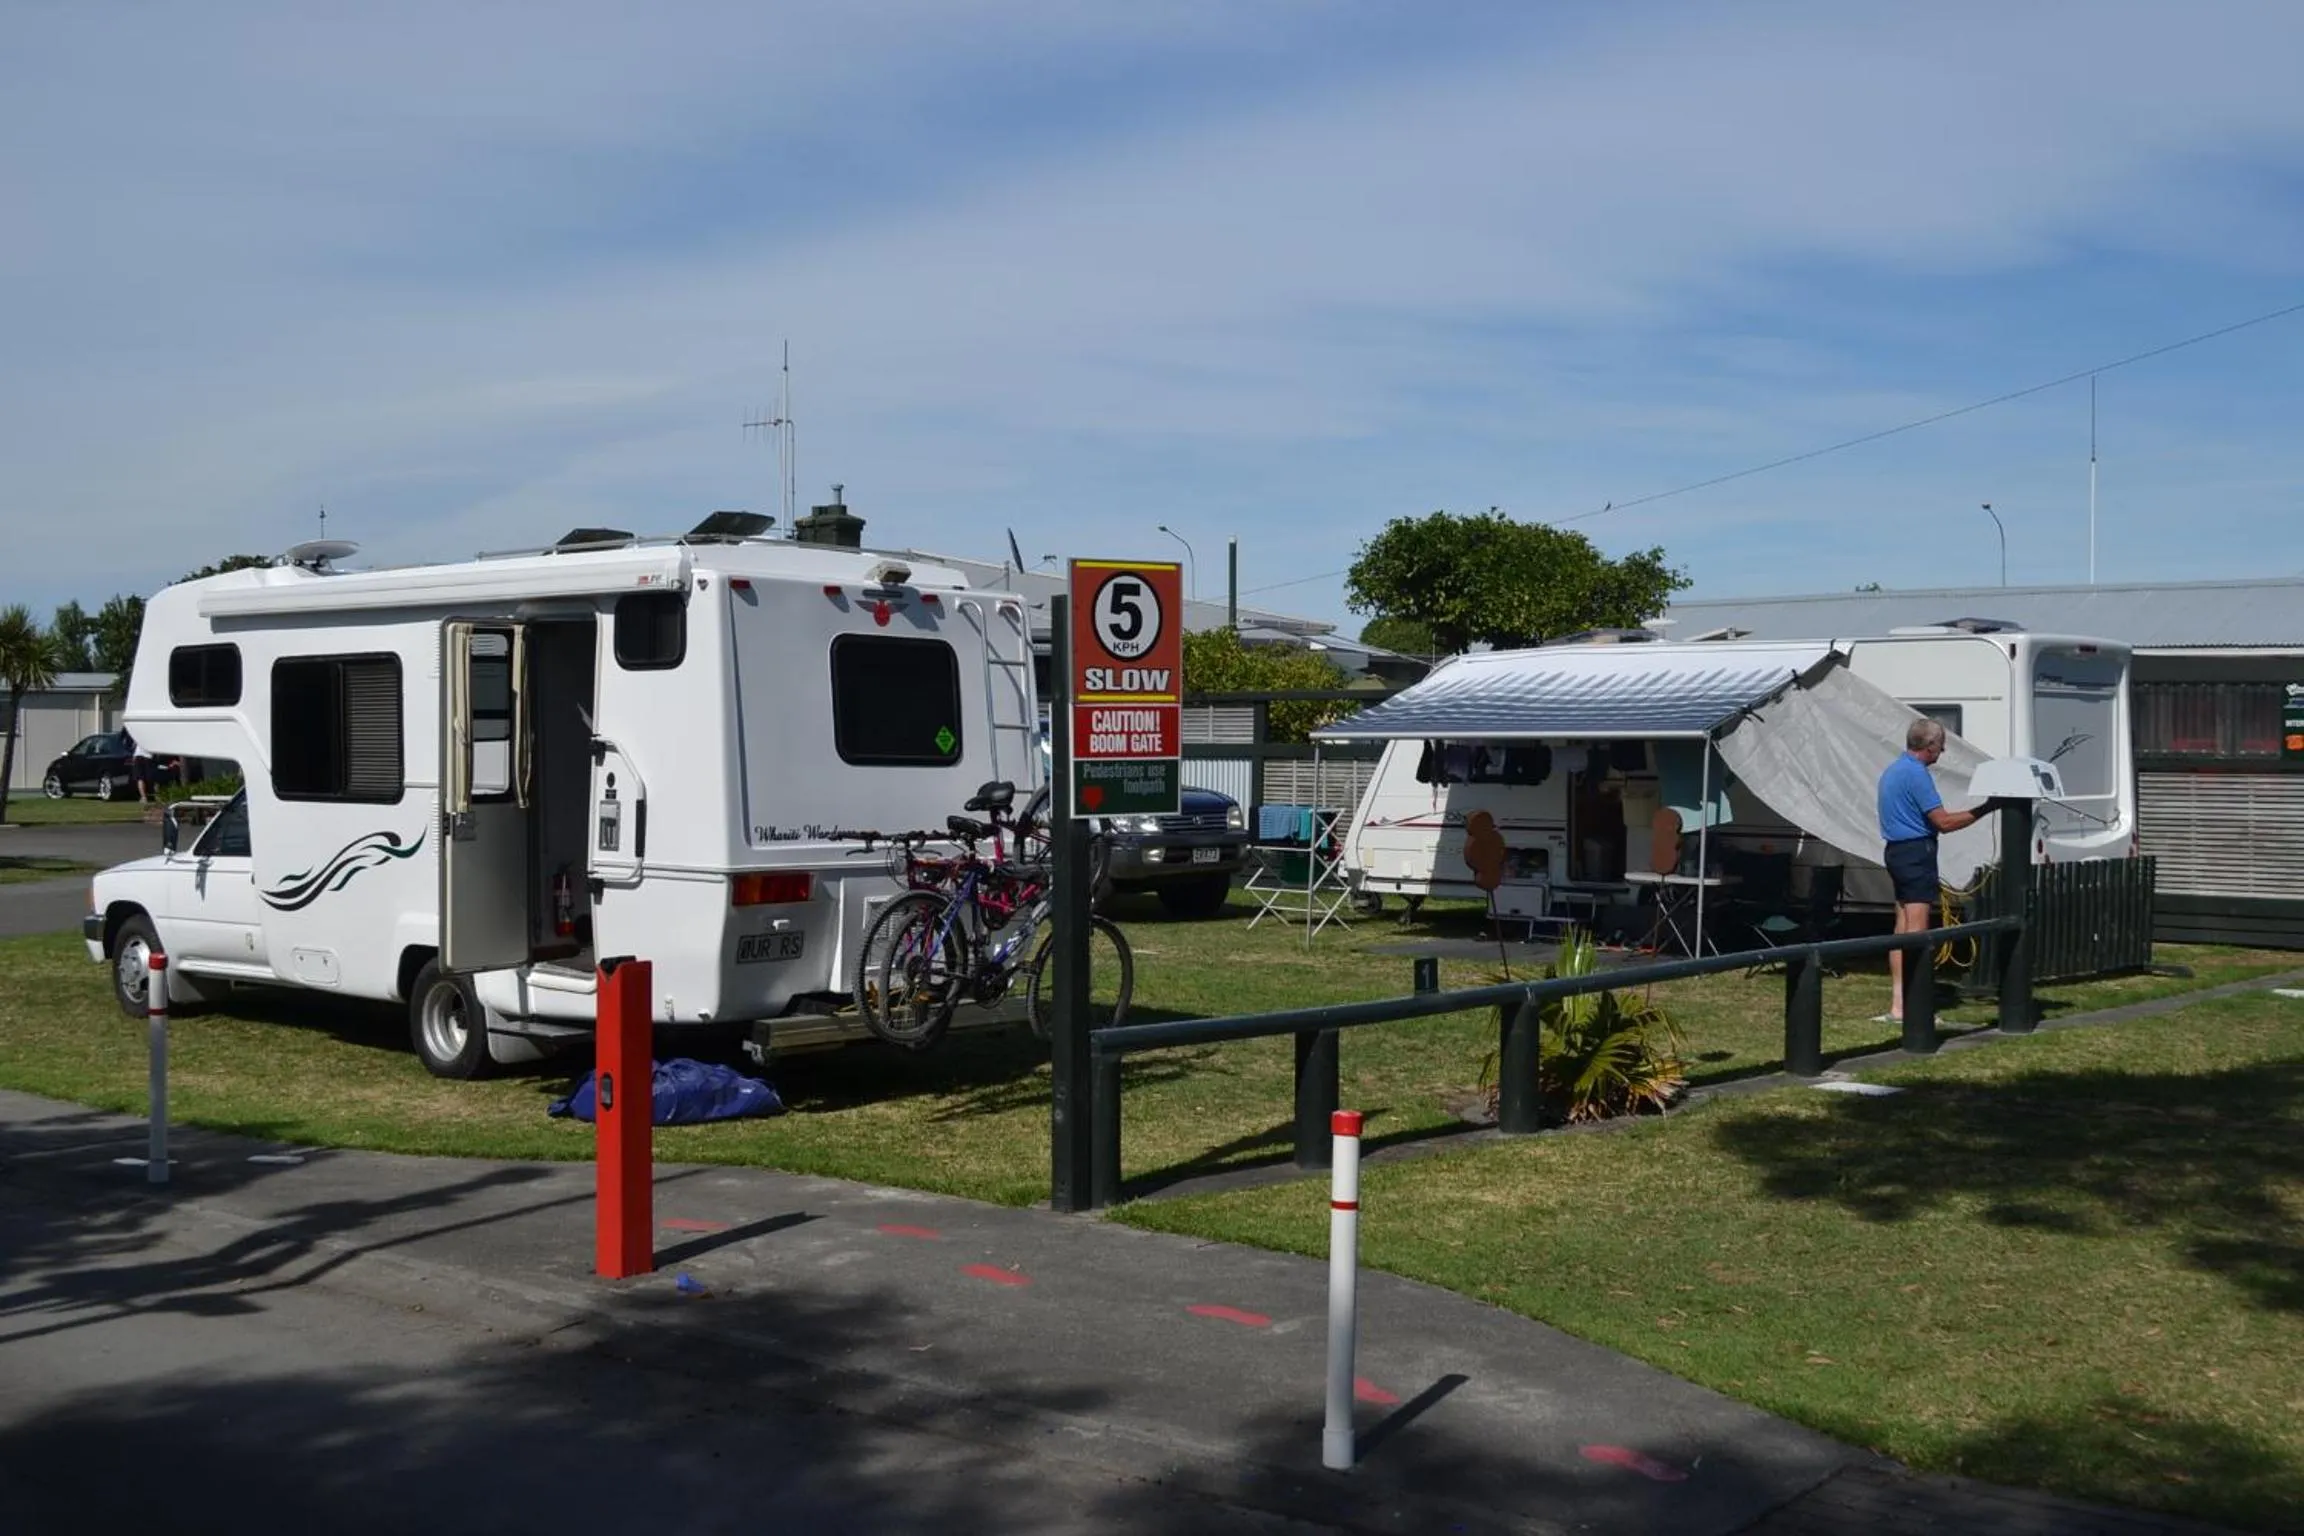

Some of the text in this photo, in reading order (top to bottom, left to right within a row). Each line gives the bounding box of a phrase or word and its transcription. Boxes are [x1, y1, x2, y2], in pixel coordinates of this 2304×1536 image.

[1109, 582, 1144, 641] 5
[1113, 641, 1140, 653] KPH
[1084, 667, 1171, 692] SLOW
[1091, 710, 1161, 734] CAUTION!
[1089, 732, 1163, 754] BOOM GATE
[1082, 762, 1167, 779] Pedestrians use
[1123, 777, 1166, 795] footpath
